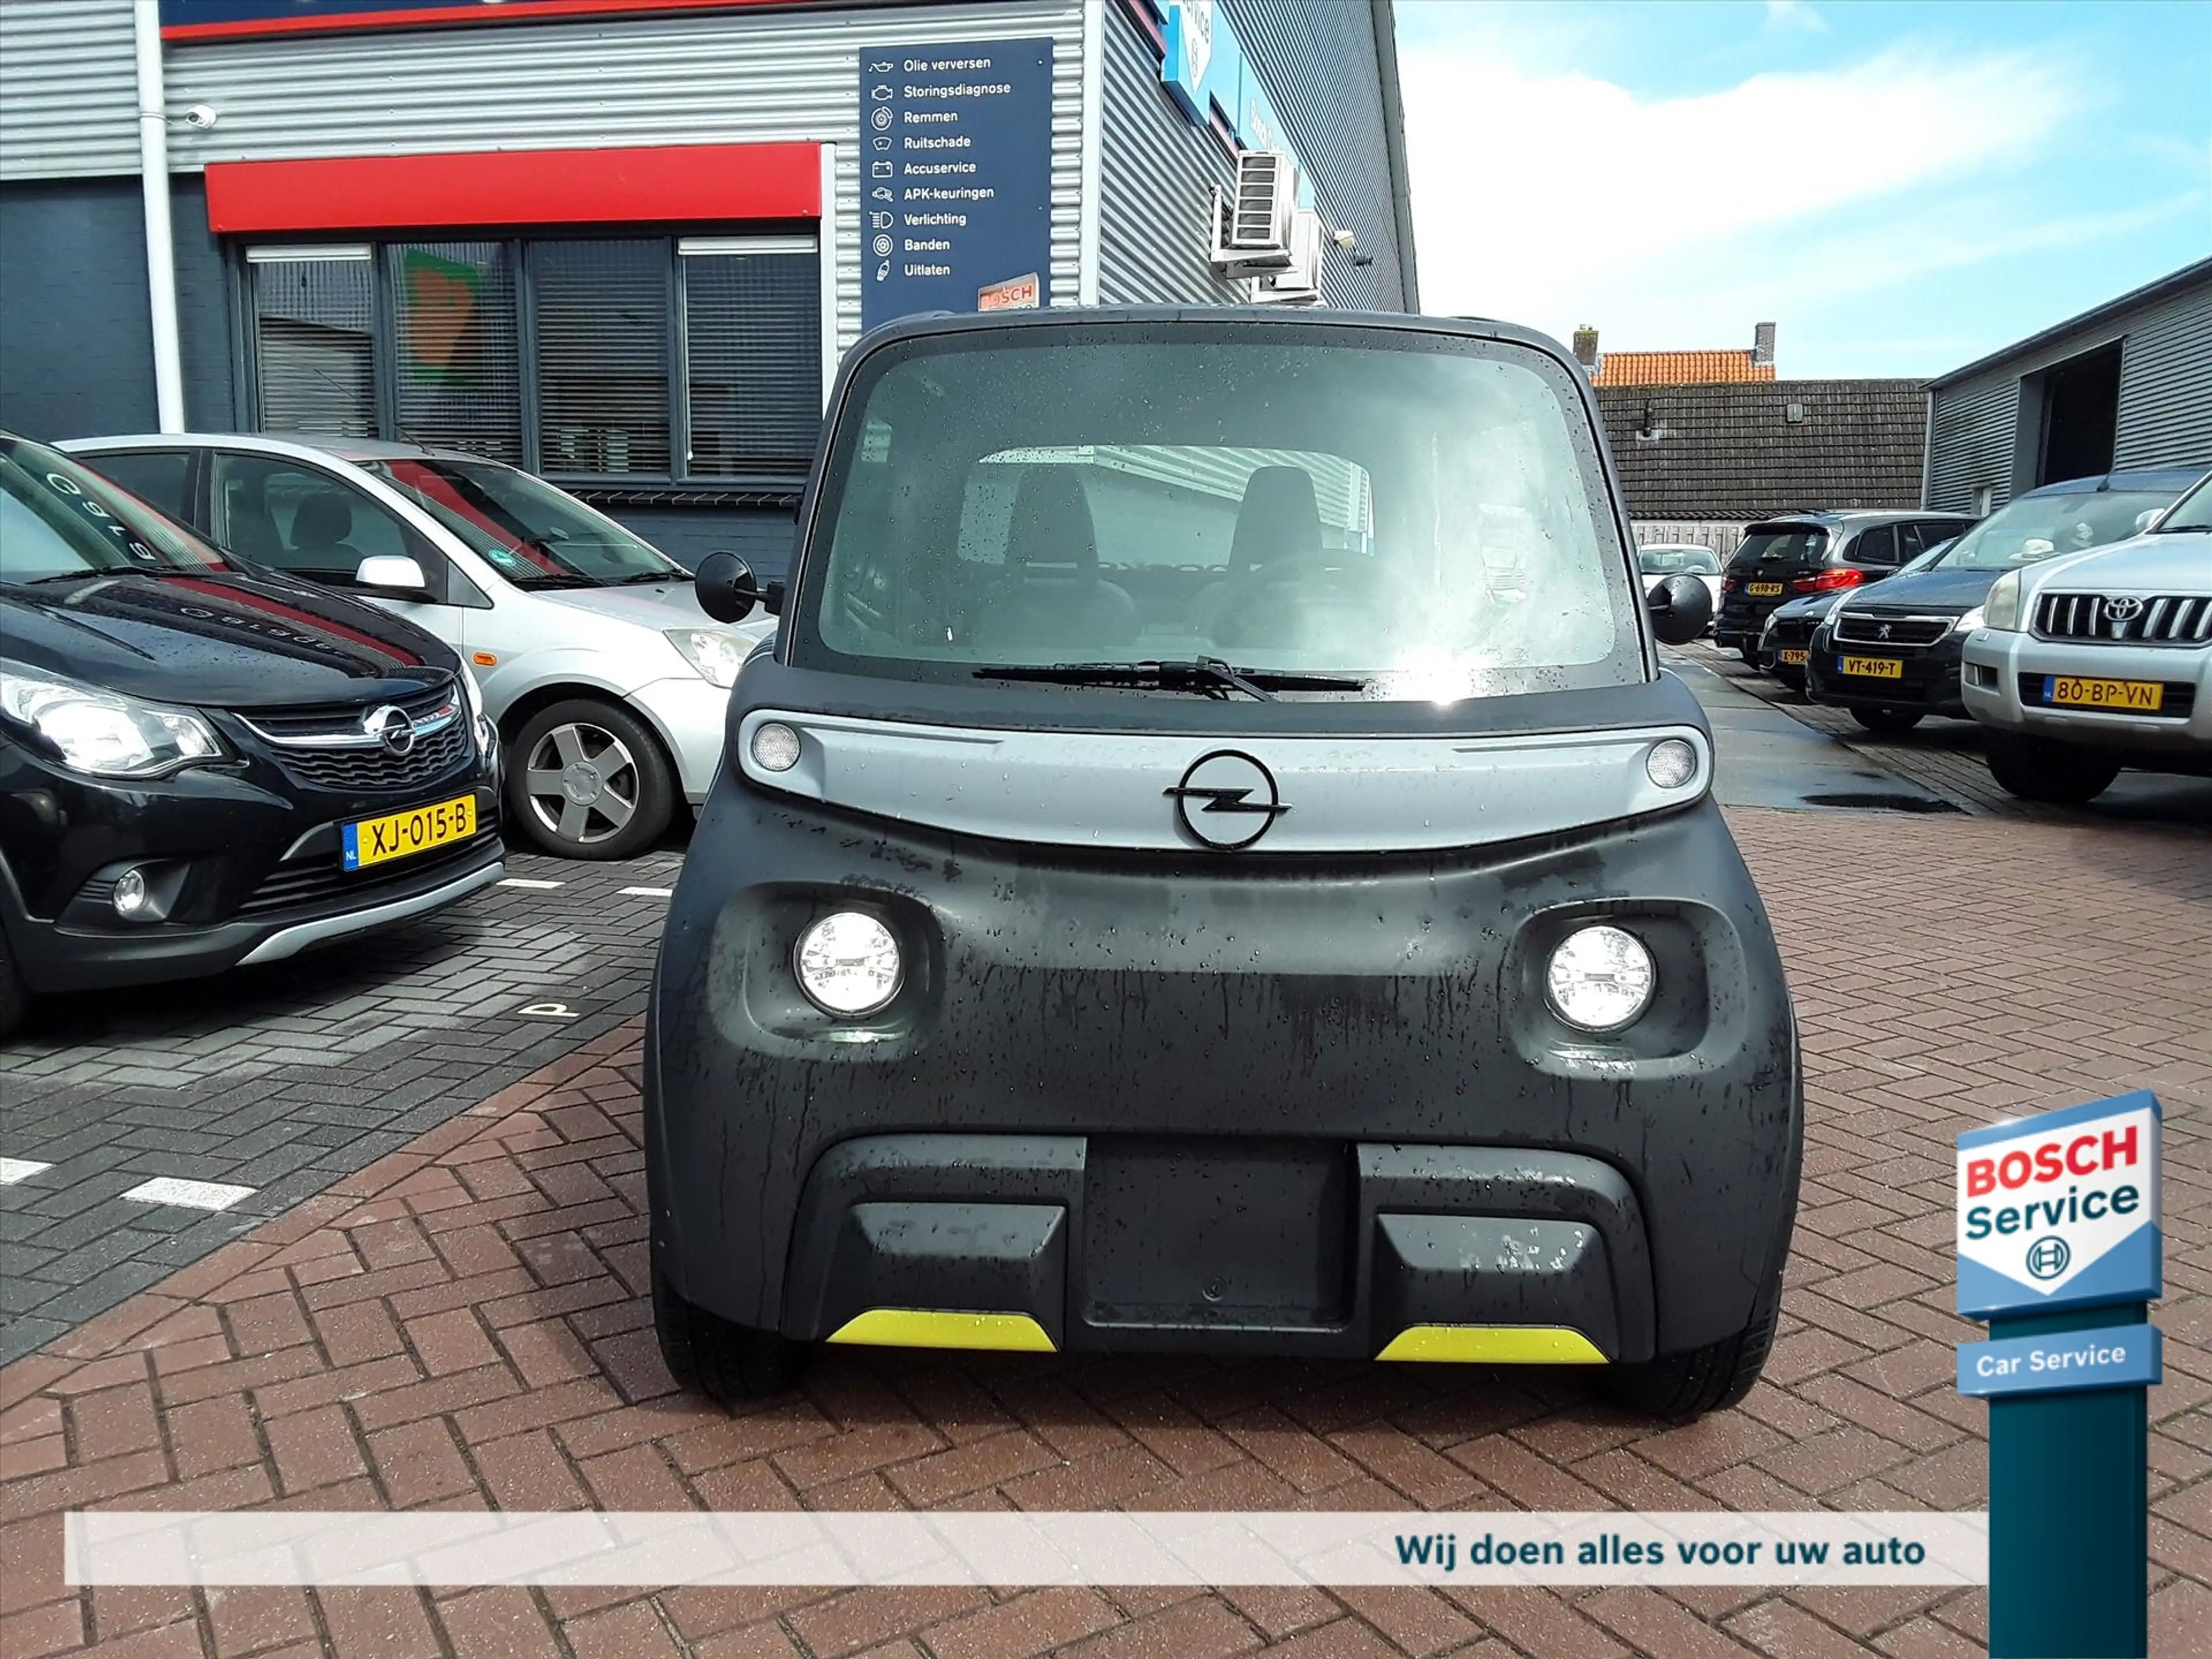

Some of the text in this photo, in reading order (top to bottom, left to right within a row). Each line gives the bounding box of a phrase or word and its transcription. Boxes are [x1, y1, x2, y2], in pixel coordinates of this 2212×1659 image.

[904, 59, 991, 72] Olie verversen
[904, 83, 1011, 99] Storingsdiagnose
[904, 111, 958, 123] Remmen
[904, 136, 971, 149] Ruitschade
[904, 161, 976, 175] Accuservice
[904, 187, 994, 200] APK-keuringen
[904, 213, 967, 226] Verlichting
[904, 238, 950, 251] Banden
[904, 264, 950, 276] Uitlaten
[1849, 660, 1896, 676] VT-419-T
[2057, 681, 2154, 706] 80-BP-VN
[346, 802, 467, 861] NL XJ-015-B
